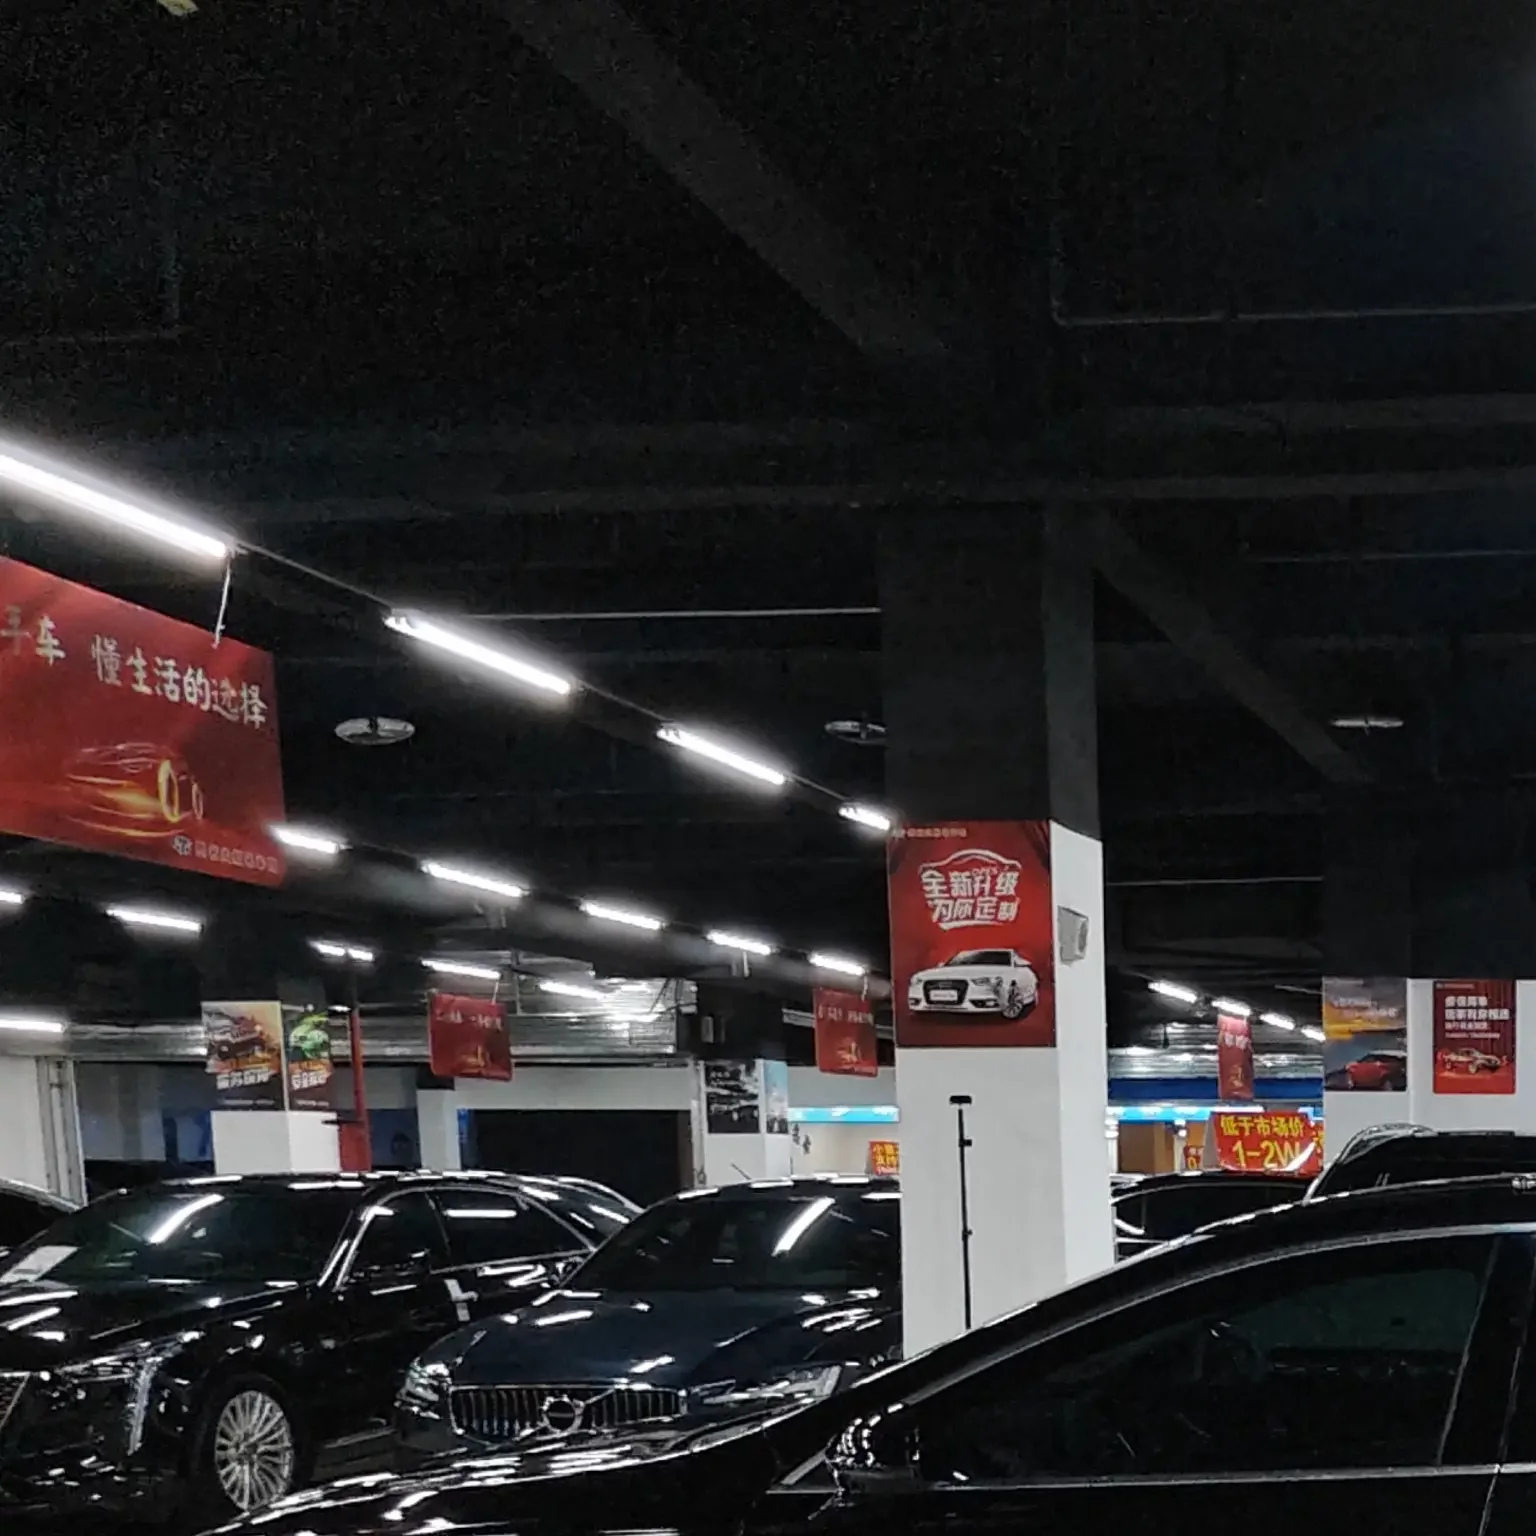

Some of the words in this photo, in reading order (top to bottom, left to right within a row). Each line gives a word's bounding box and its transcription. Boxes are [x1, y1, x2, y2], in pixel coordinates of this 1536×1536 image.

[91, 634, 268, 729] 懂生活的选择
[921, 866, 1020, 897] 全新升级
[1220, 1115, 1304, 1137] 低于市场价
